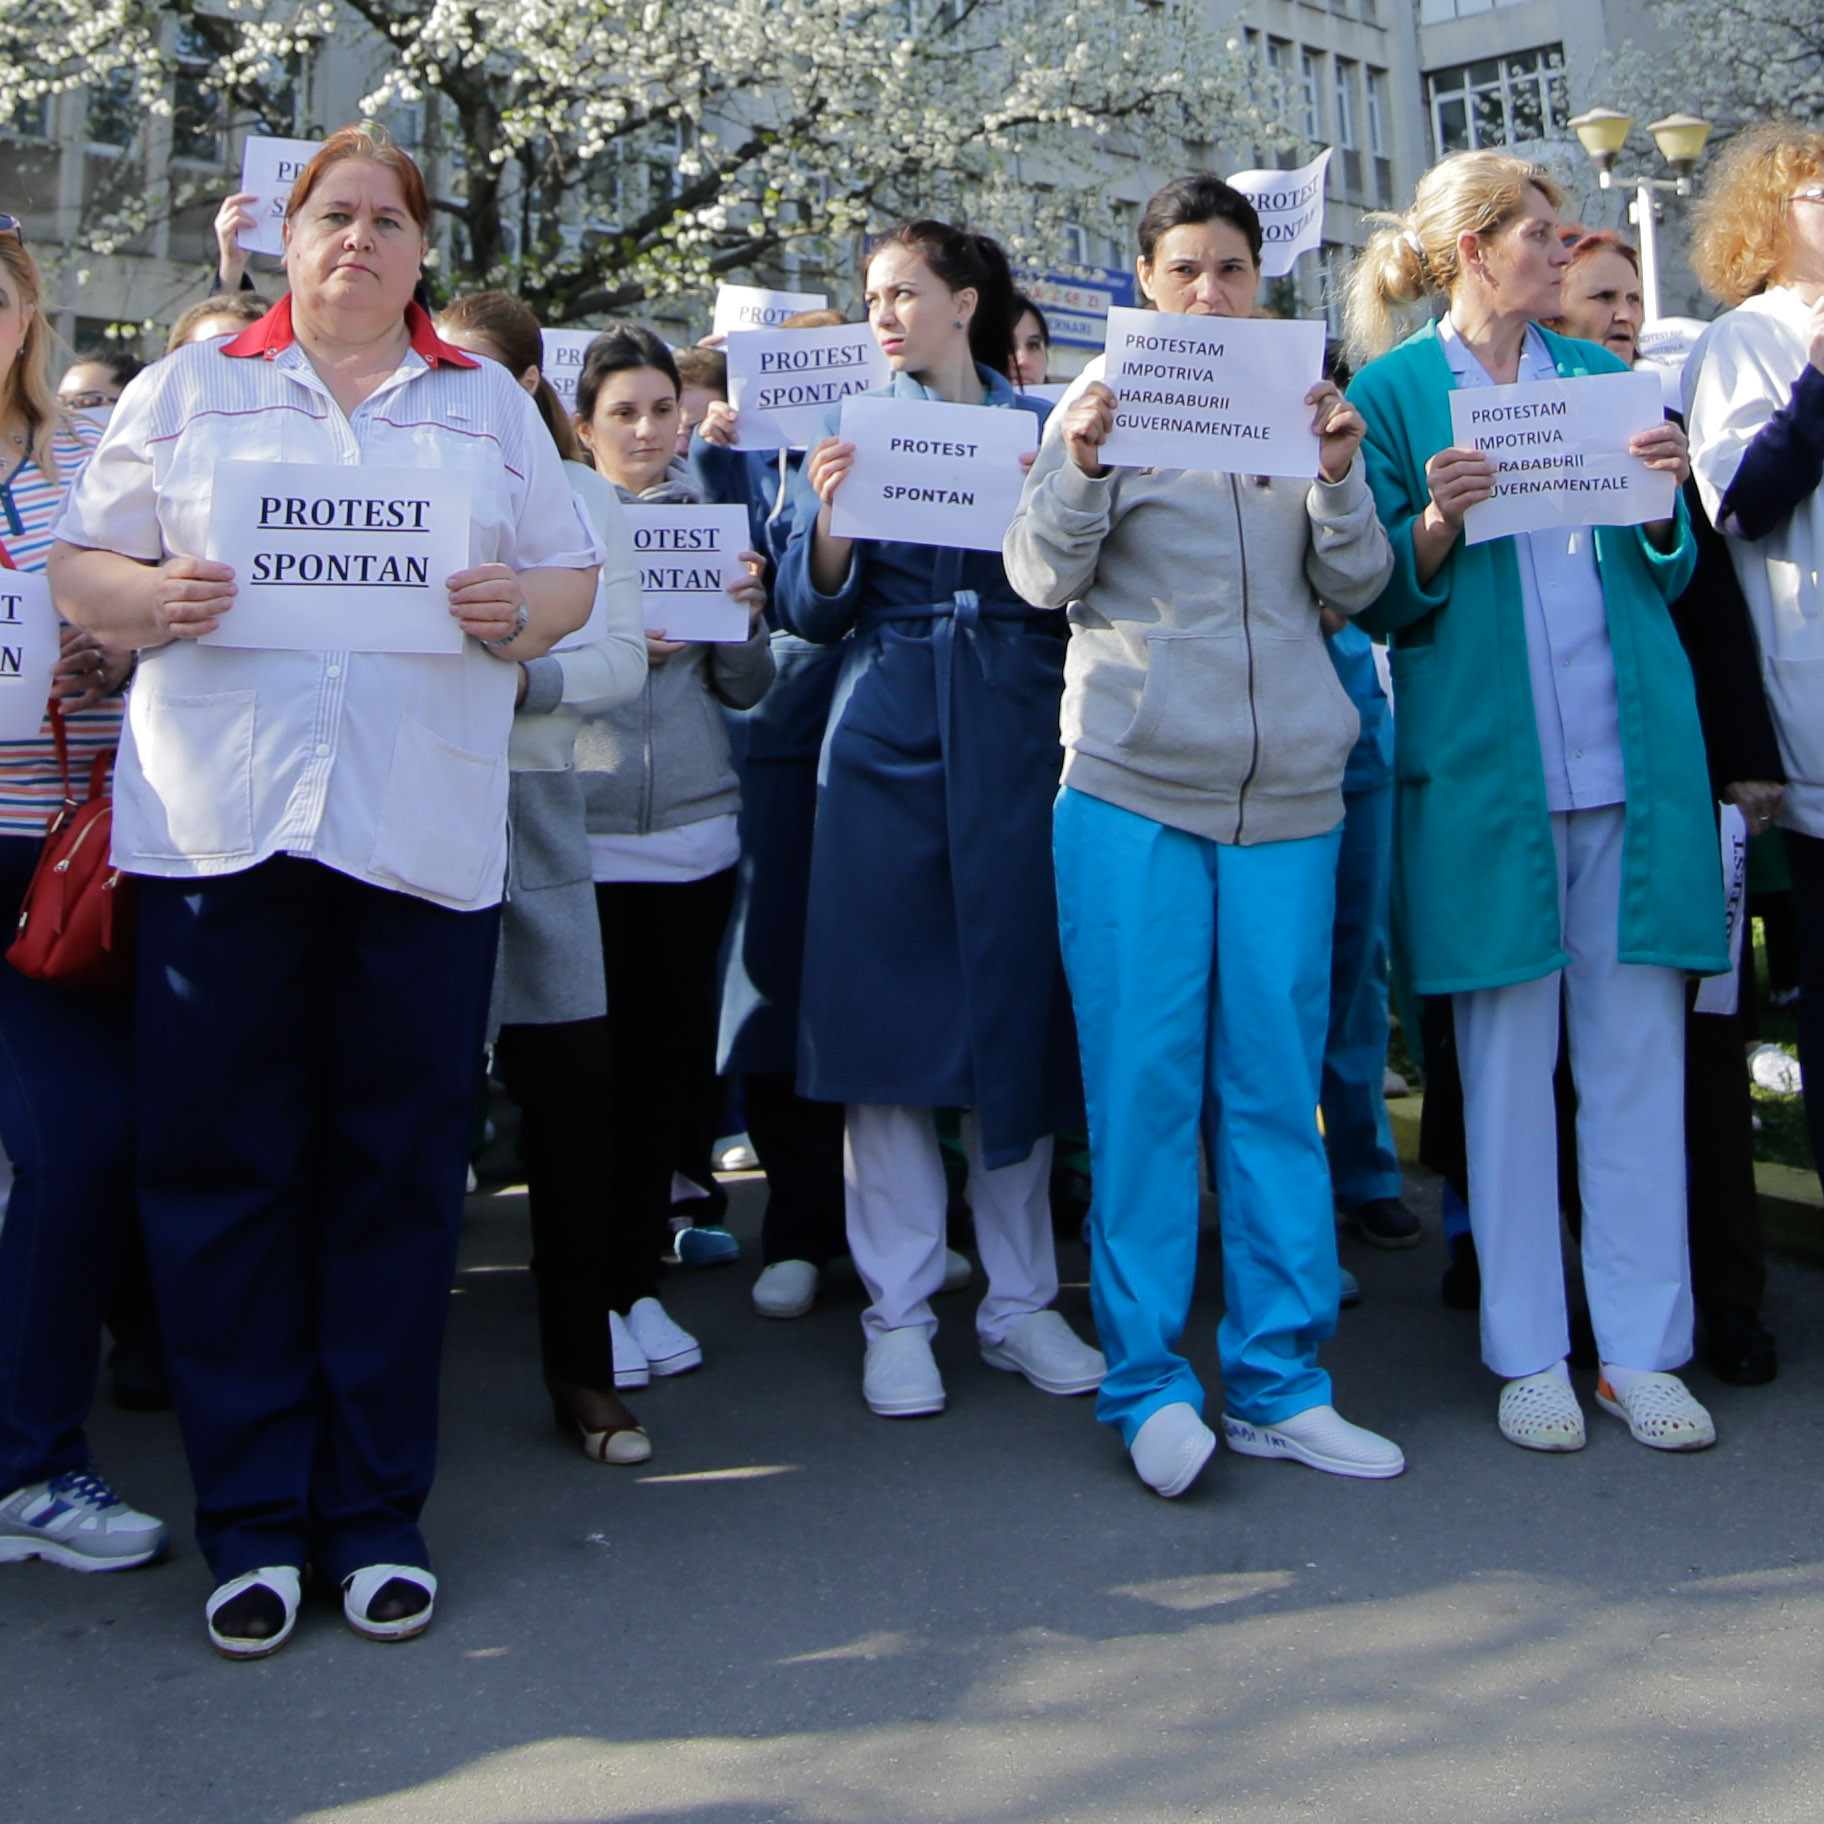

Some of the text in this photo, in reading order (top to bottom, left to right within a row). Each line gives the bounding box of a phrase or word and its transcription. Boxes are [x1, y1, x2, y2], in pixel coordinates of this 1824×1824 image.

[739, 305, 798, 324] PROT
[1125, 334, 1225, 357] PROTESTAM
[760, 344, 868, 371] PROTEST
[1122, 361, 1215, 383] IMPOTRIVA
[759, 379, 869, 407] SPONTAN
[1119, 388, 1231, 410] HARABABURII
[1472, 401, 1567, 424] PROTESTAM
[1115, 414, 1271, 440] GUVERNAMENTALE
[890, 438, 978, 457] PROTEST
[1474, 429, 1564, 450] IMPOTRIVA
[1495, 454, 1584, 473] RABABURII
[883, 485, 975, 506] SPONTAN
[1490, 476, 1629, 498] UVERNAMENTALE
[259, 496, 431, 528] PROTEST
[634, 528, 720, 548] OTEST
[251, 553, 430, 583] SPONTAN
